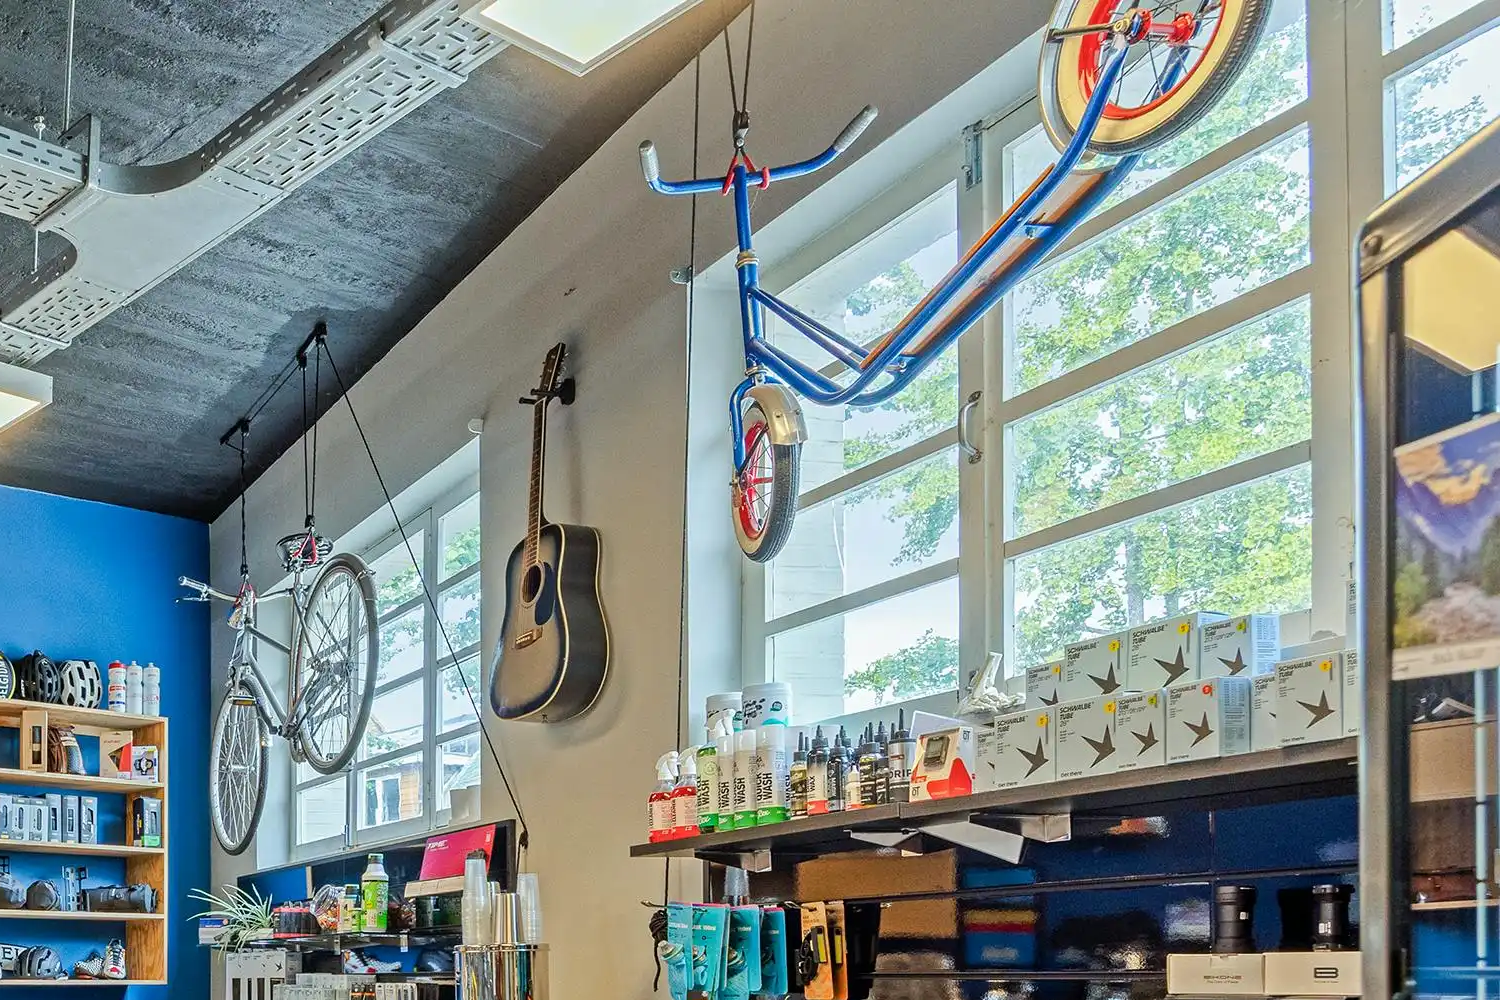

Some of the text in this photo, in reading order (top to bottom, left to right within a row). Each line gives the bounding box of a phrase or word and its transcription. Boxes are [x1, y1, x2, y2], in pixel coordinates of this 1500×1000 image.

[1132, 626, 1165, 638] SCHWALBE
[1132, 636, 1147, 644] TUBE
[1067, 644, 1097, 654] SCHWALBE
[1278, 661, 1312, 672] SCHWALBE
[1278, 670, 1293, 678] TUBE
[1059, 703, 1092, 714] SCHWALBE
[1059, 712, 1074, 720] TUBE
[997, 717, 1026, 727] SCHWALBE
[997, 725, 1010, 733] TUBE
[737, 777, 746, 805] WASH
[762, 772, 772, 801] WASH
[701, 779, 710, 806] WASH
[721, 781, 729, 808] WASH
